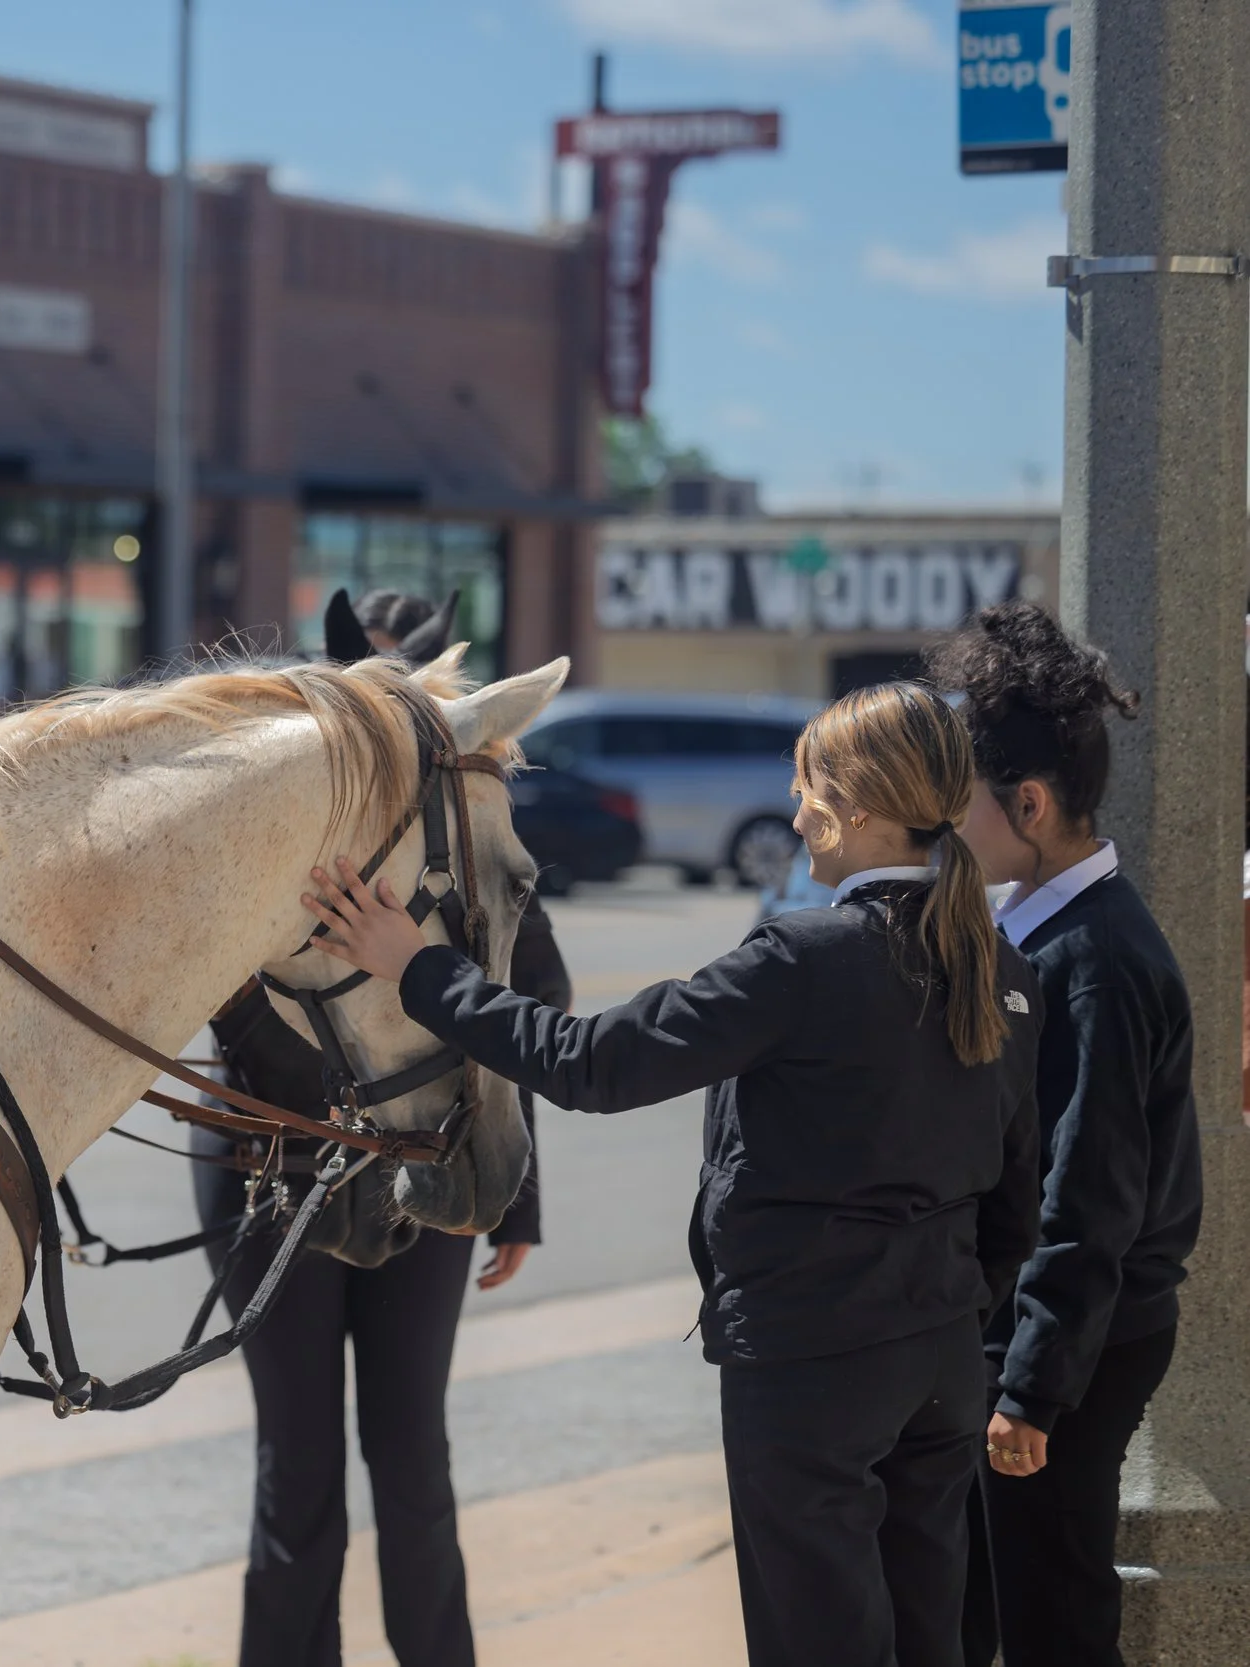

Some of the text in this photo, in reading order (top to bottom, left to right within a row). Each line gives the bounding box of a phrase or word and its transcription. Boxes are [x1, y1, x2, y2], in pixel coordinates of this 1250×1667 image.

[961, 30, 1022, 60] bus
[961, 60, 1037, 92] stop
[595, 550, 730, 629] CAR
[1009, 990, 1020, 998] THE
